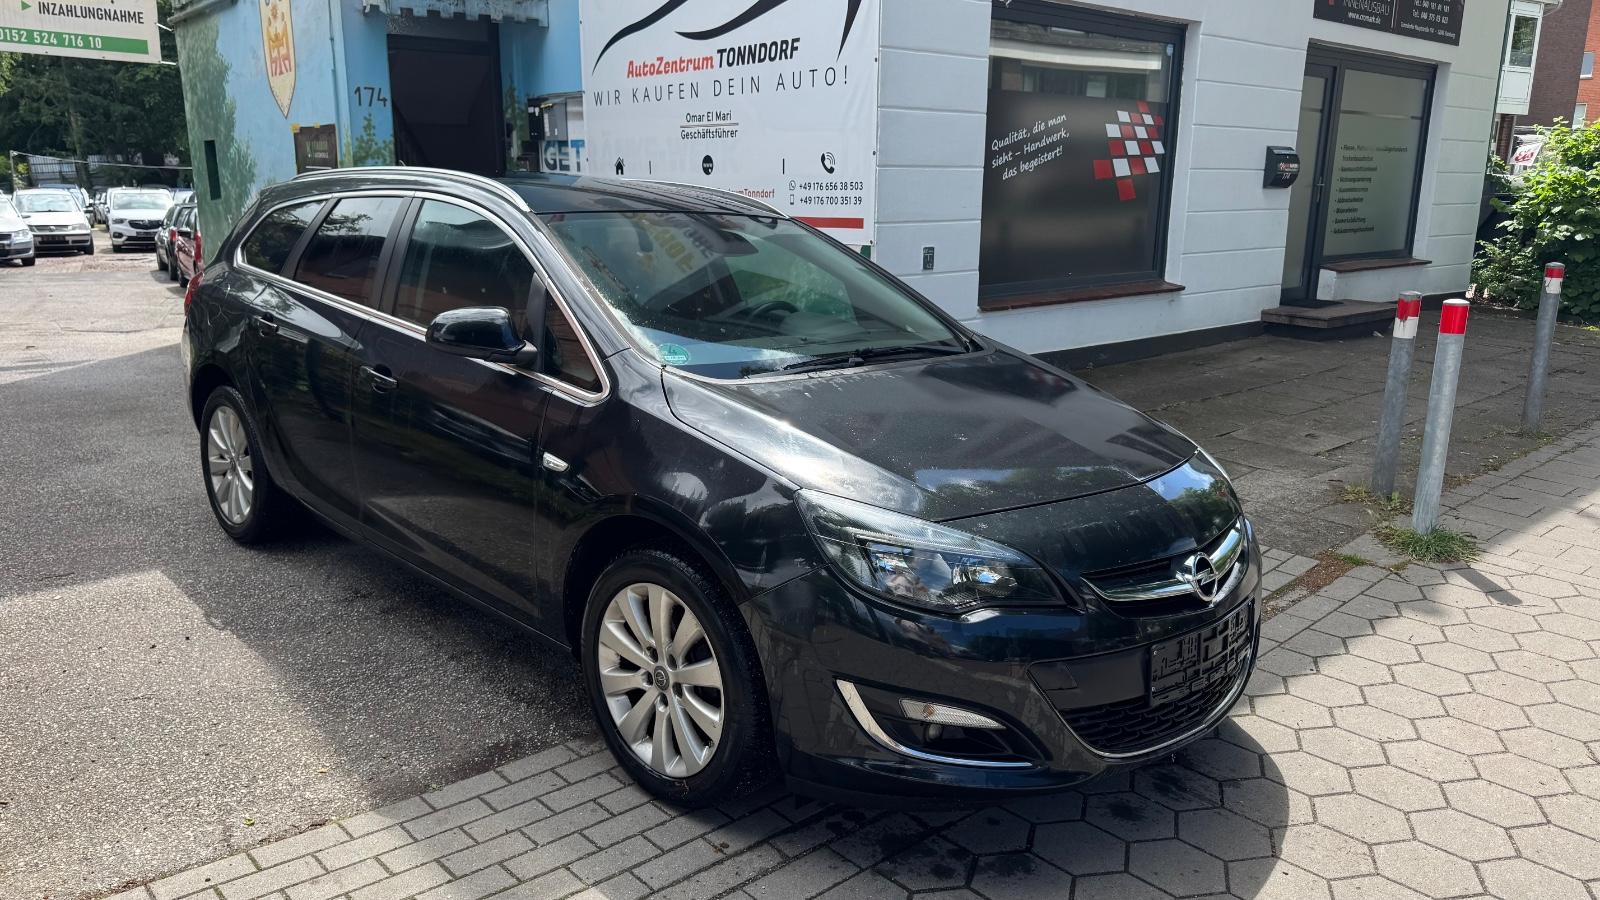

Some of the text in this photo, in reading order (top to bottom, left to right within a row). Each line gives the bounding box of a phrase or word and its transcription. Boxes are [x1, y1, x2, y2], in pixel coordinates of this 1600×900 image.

[38, 1, 145, 24] INZAHLUNGNAHME
[34, 32, 57, 45] 524
[63, 34, 84, 47] 716
[89, 37, 102, 49] 10
[627, 37, 800, 78] AutoZentrum TONNDORF
[354, 86, 388, 107] 174
[593, 65, 847, 107] WIR KAUFEN DEIN AUTO!
[685, 110, 732, 123] Omar El Mari
[680, 128, 738, 140] Geschäftsführer
[991, 114, 1067, 151] Qualität, die man
[991, 151, 1013, 168] sieht
[1023, 128, 1070, 155] Handwerk,
[1002, 145, 1063, 180] das begeistert!
[799, 181, 864, 191] +49 176 656 38 503
[800, 196, 863, 206] +49 176 700 351 39
